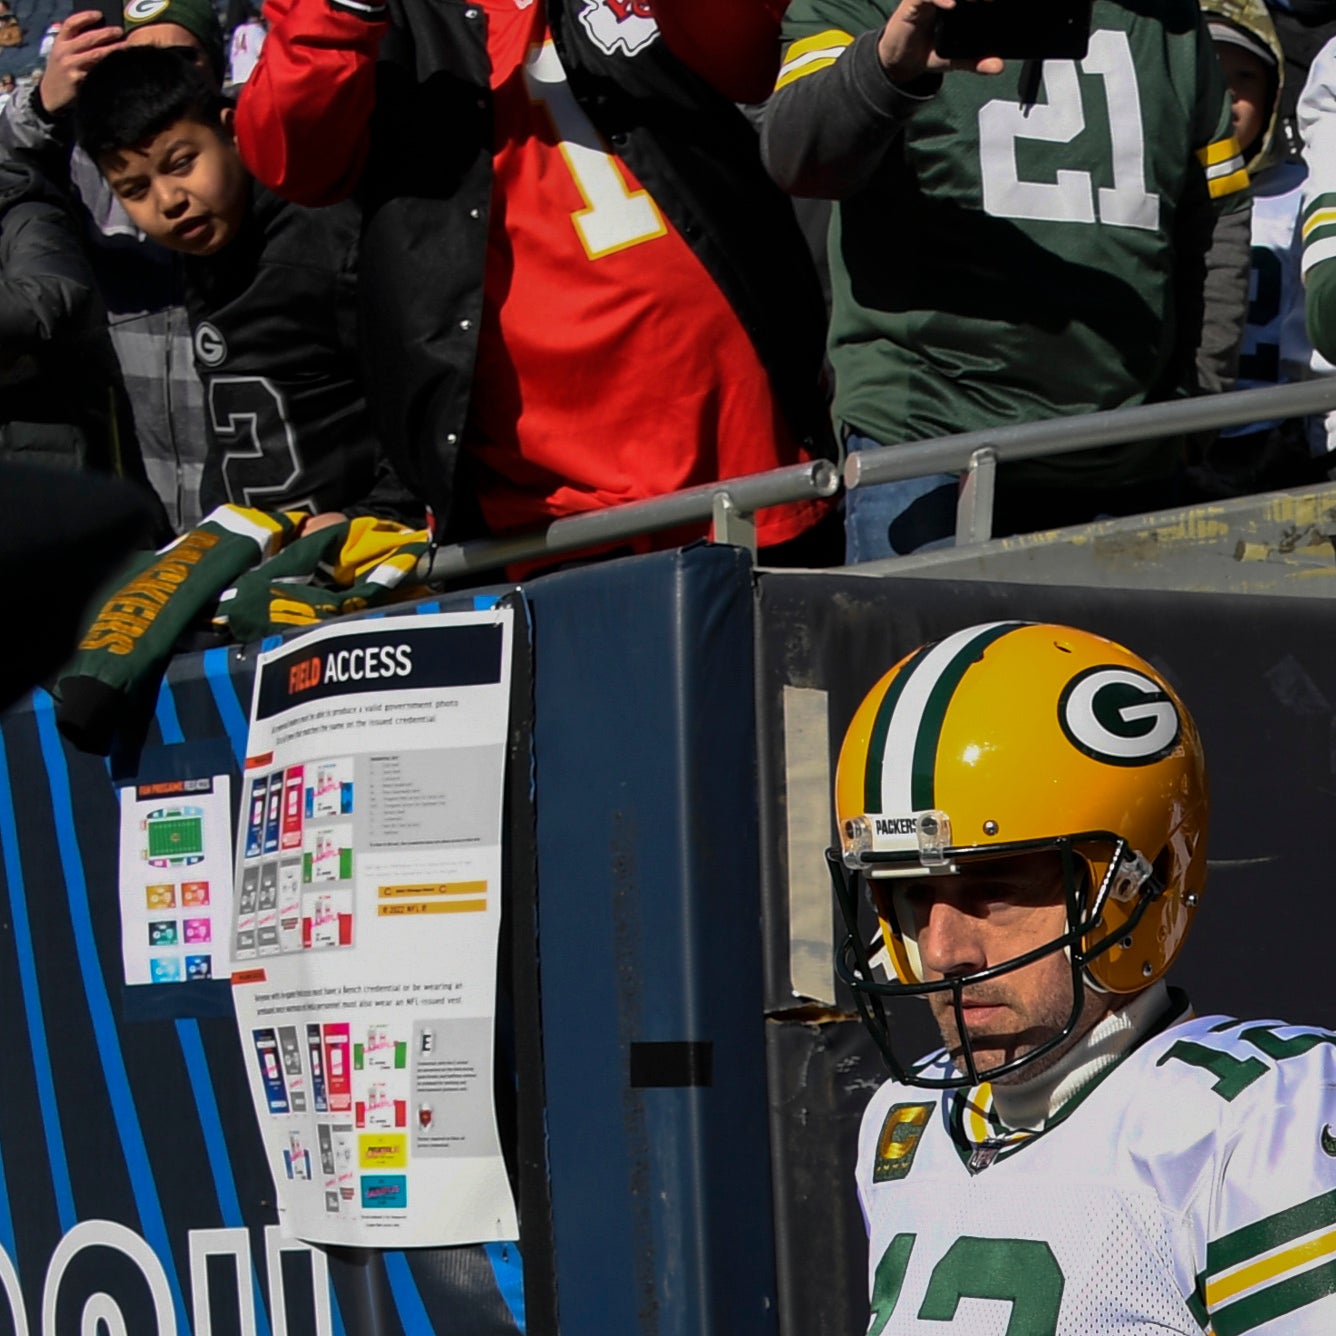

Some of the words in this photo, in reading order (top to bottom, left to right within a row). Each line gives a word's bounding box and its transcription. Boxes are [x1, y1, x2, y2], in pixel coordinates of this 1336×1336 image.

[288, 655, 322, 695] FIELD
[324, 644, 413, 684] ACCESS
[385, 701, 433, 713] government
[435, 699, 459, 710] photo
[1064, 667, 1181, 762] G
[423, 981, 452, 992] wearing
[881, 1105, 927, 1160] C
